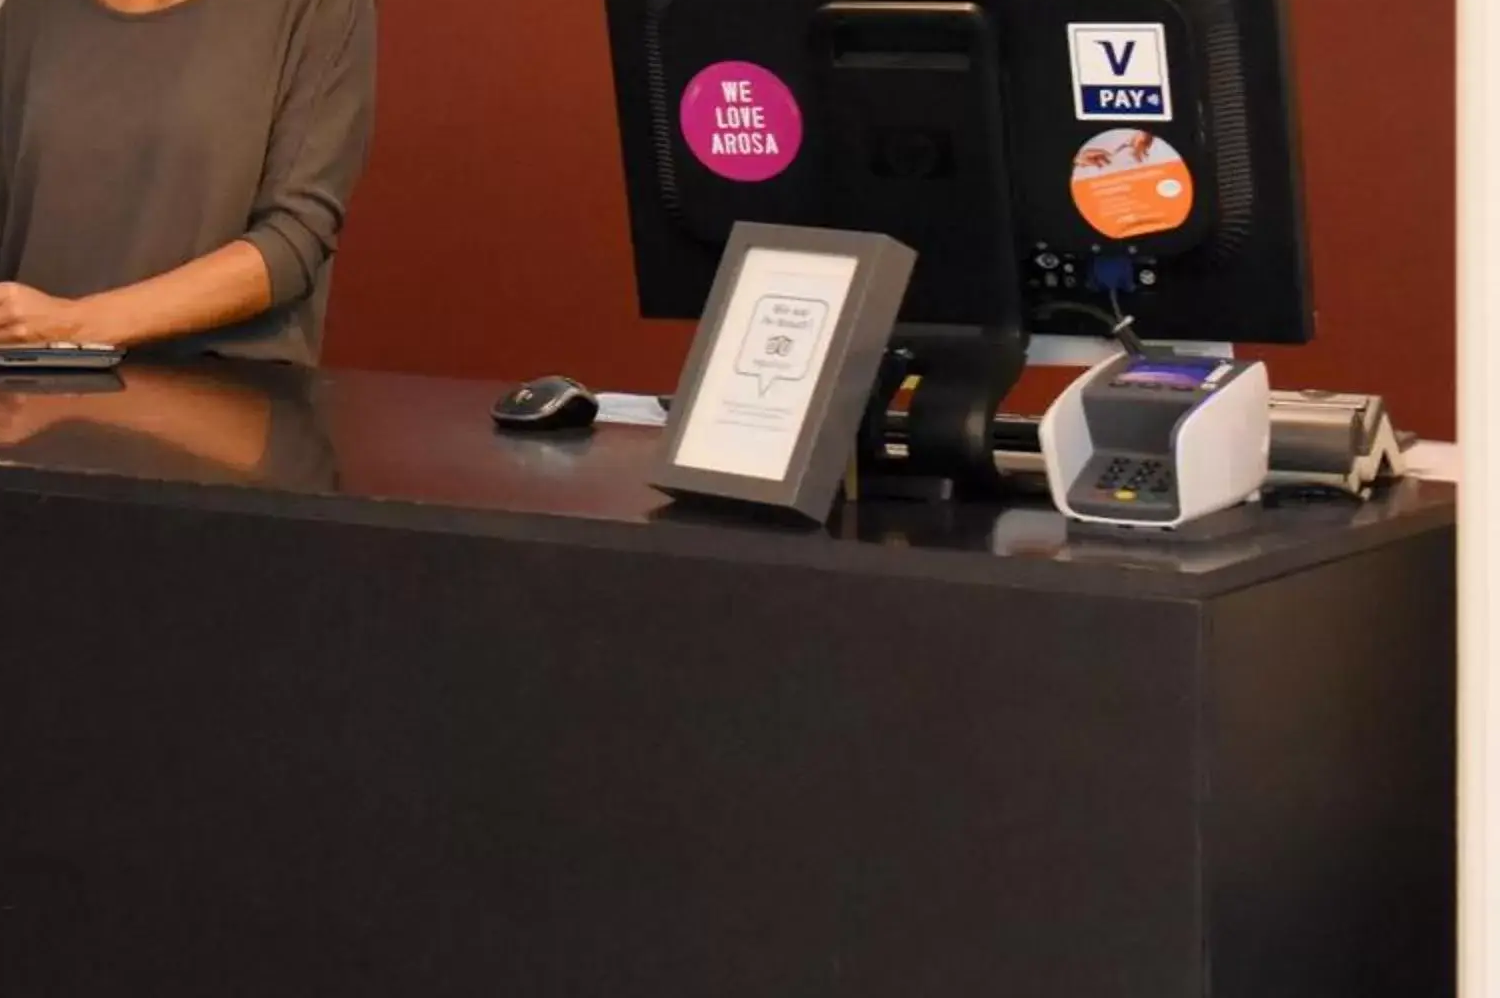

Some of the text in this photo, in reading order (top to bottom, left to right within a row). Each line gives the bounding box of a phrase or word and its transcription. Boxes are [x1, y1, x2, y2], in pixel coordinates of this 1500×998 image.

[1093, 40, 1136, 77] V
[721, 80, 753, 103] WE
[1099, 89, 1145, 108] PAY
[715, 106, 766, 129] LOVE
[711, 133, 779, 155] AROSA
